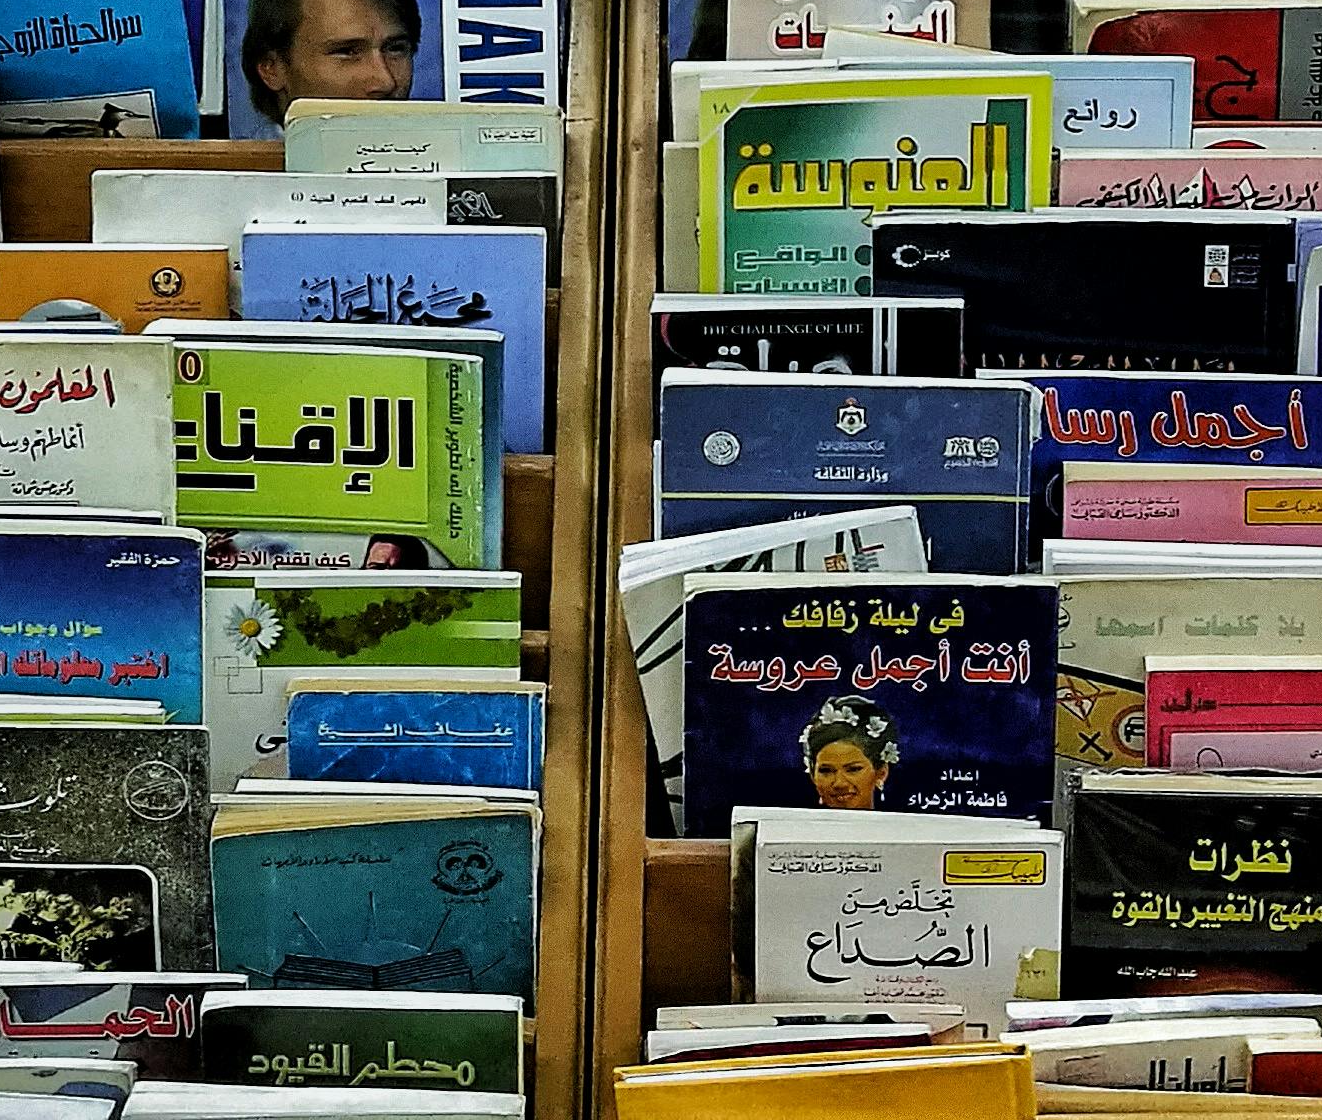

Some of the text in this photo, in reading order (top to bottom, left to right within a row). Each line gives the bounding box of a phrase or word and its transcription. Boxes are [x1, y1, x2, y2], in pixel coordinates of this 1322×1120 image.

[733, 123, 1009, 224] العنوسة
[1151, 388, 1309, 461] أجمل
[708, 639, 1031, 693] أنت أجمل عروسة
[1190, 838, 1292, 880] نظرات
[249, 1041, 475, 1086] محطم القيود
